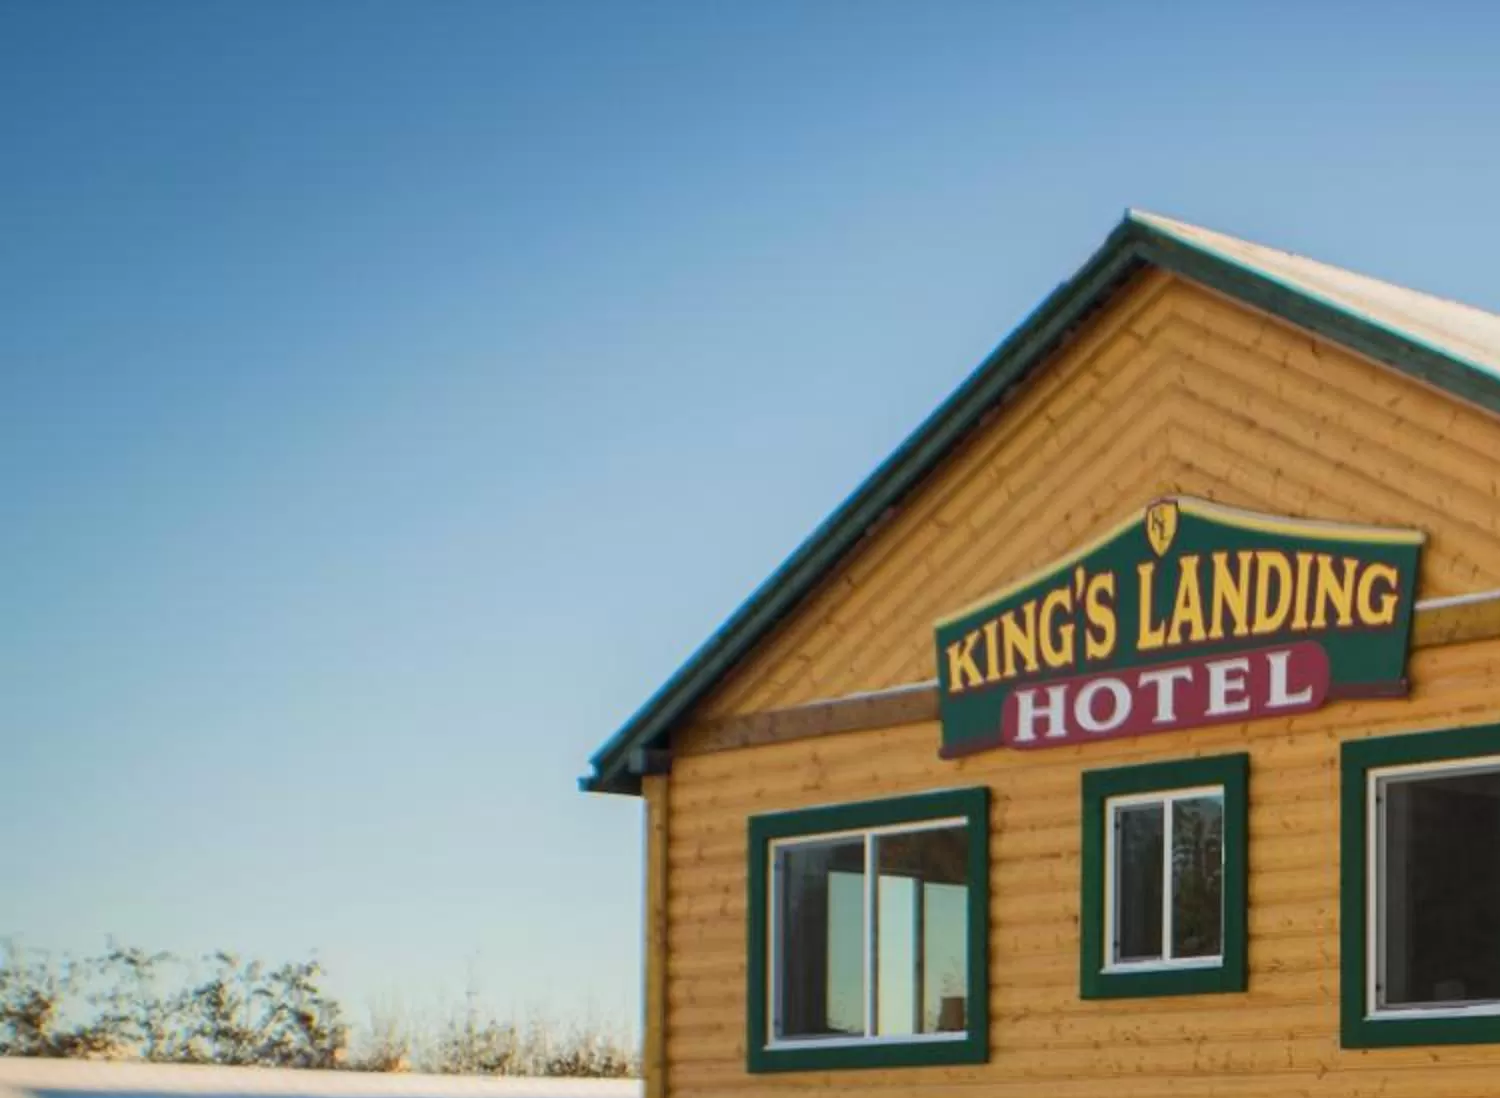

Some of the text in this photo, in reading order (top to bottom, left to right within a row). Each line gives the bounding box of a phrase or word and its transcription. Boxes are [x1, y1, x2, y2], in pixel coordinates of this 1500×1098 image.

[946, 550, 1399, 693] KING'S LANDING
[1013, 649, 1313, 742] HOTEL
